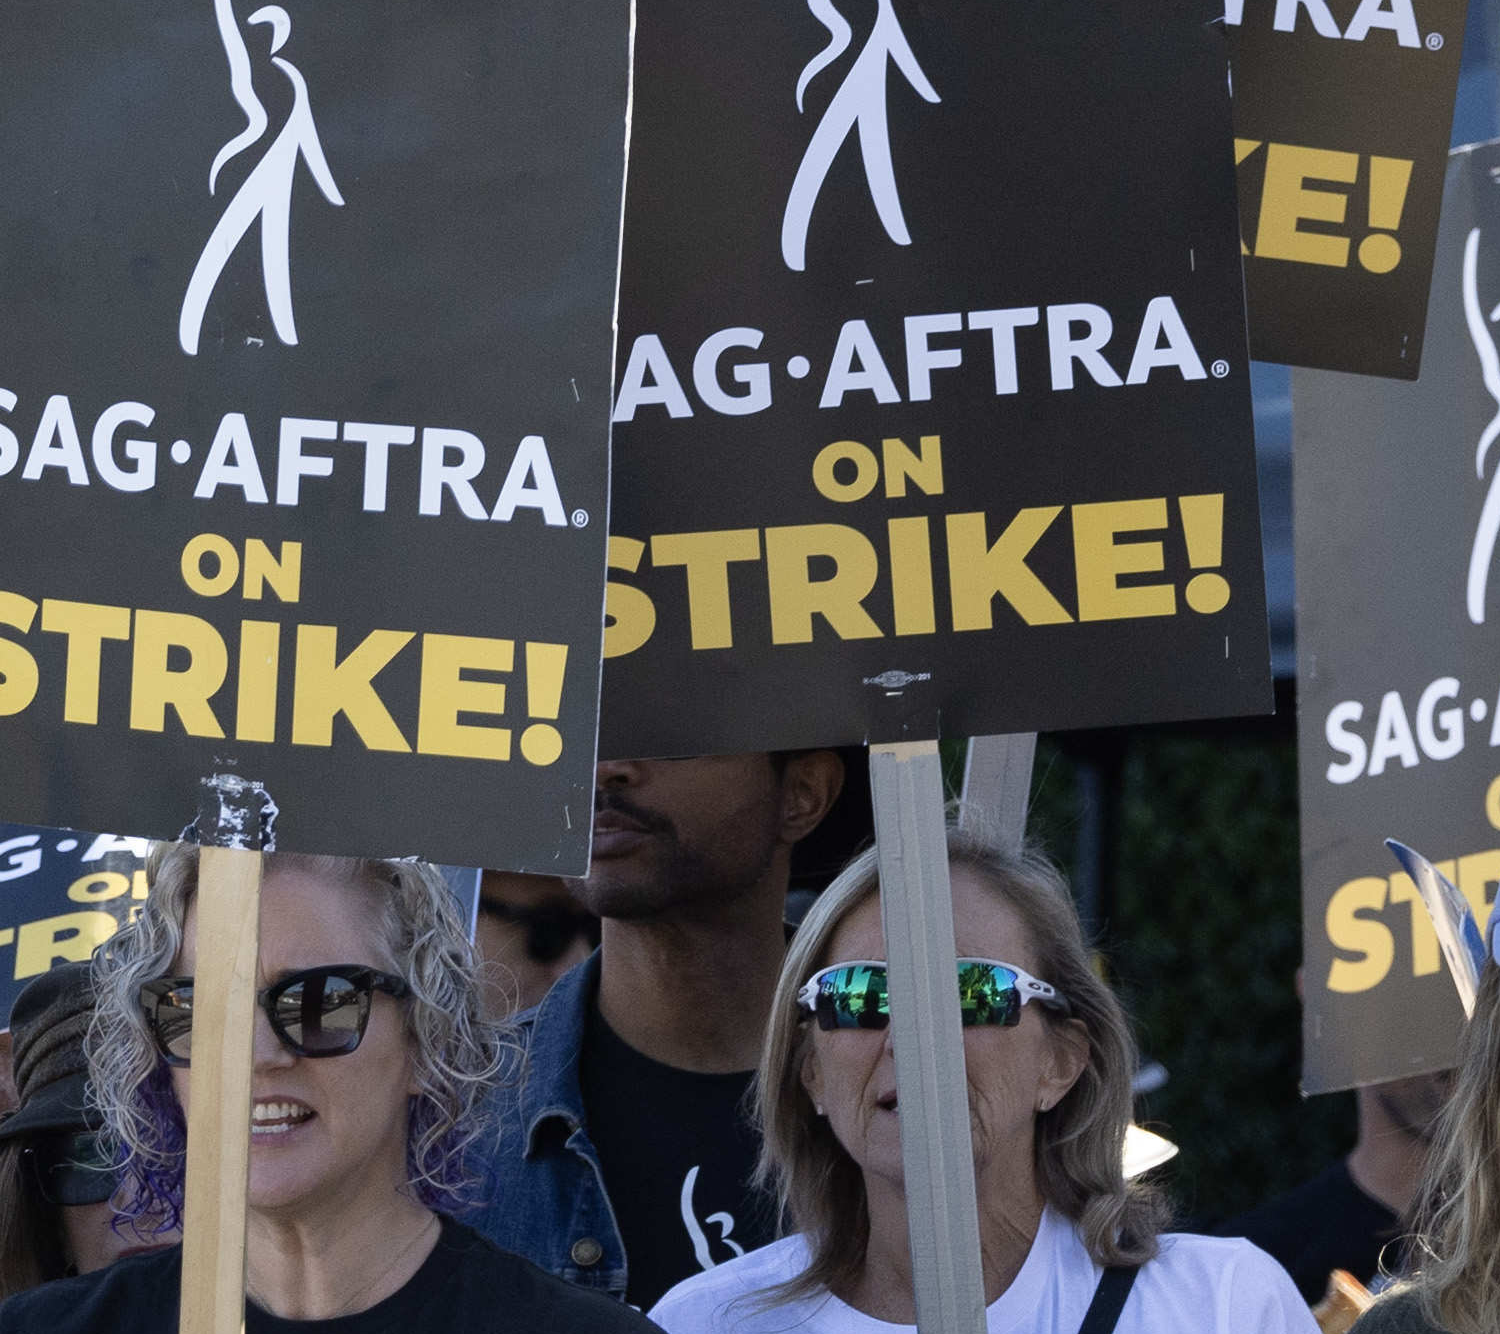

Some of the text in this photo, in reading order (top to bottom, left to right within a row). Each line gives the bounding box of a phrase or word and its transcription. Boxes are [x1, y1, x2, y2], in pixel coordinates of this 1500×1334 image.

[611, 296, 1230, 424] AG·AFTRA®
[812, 435, 945, 504] ON
[180, 533, 303, 603] ON
